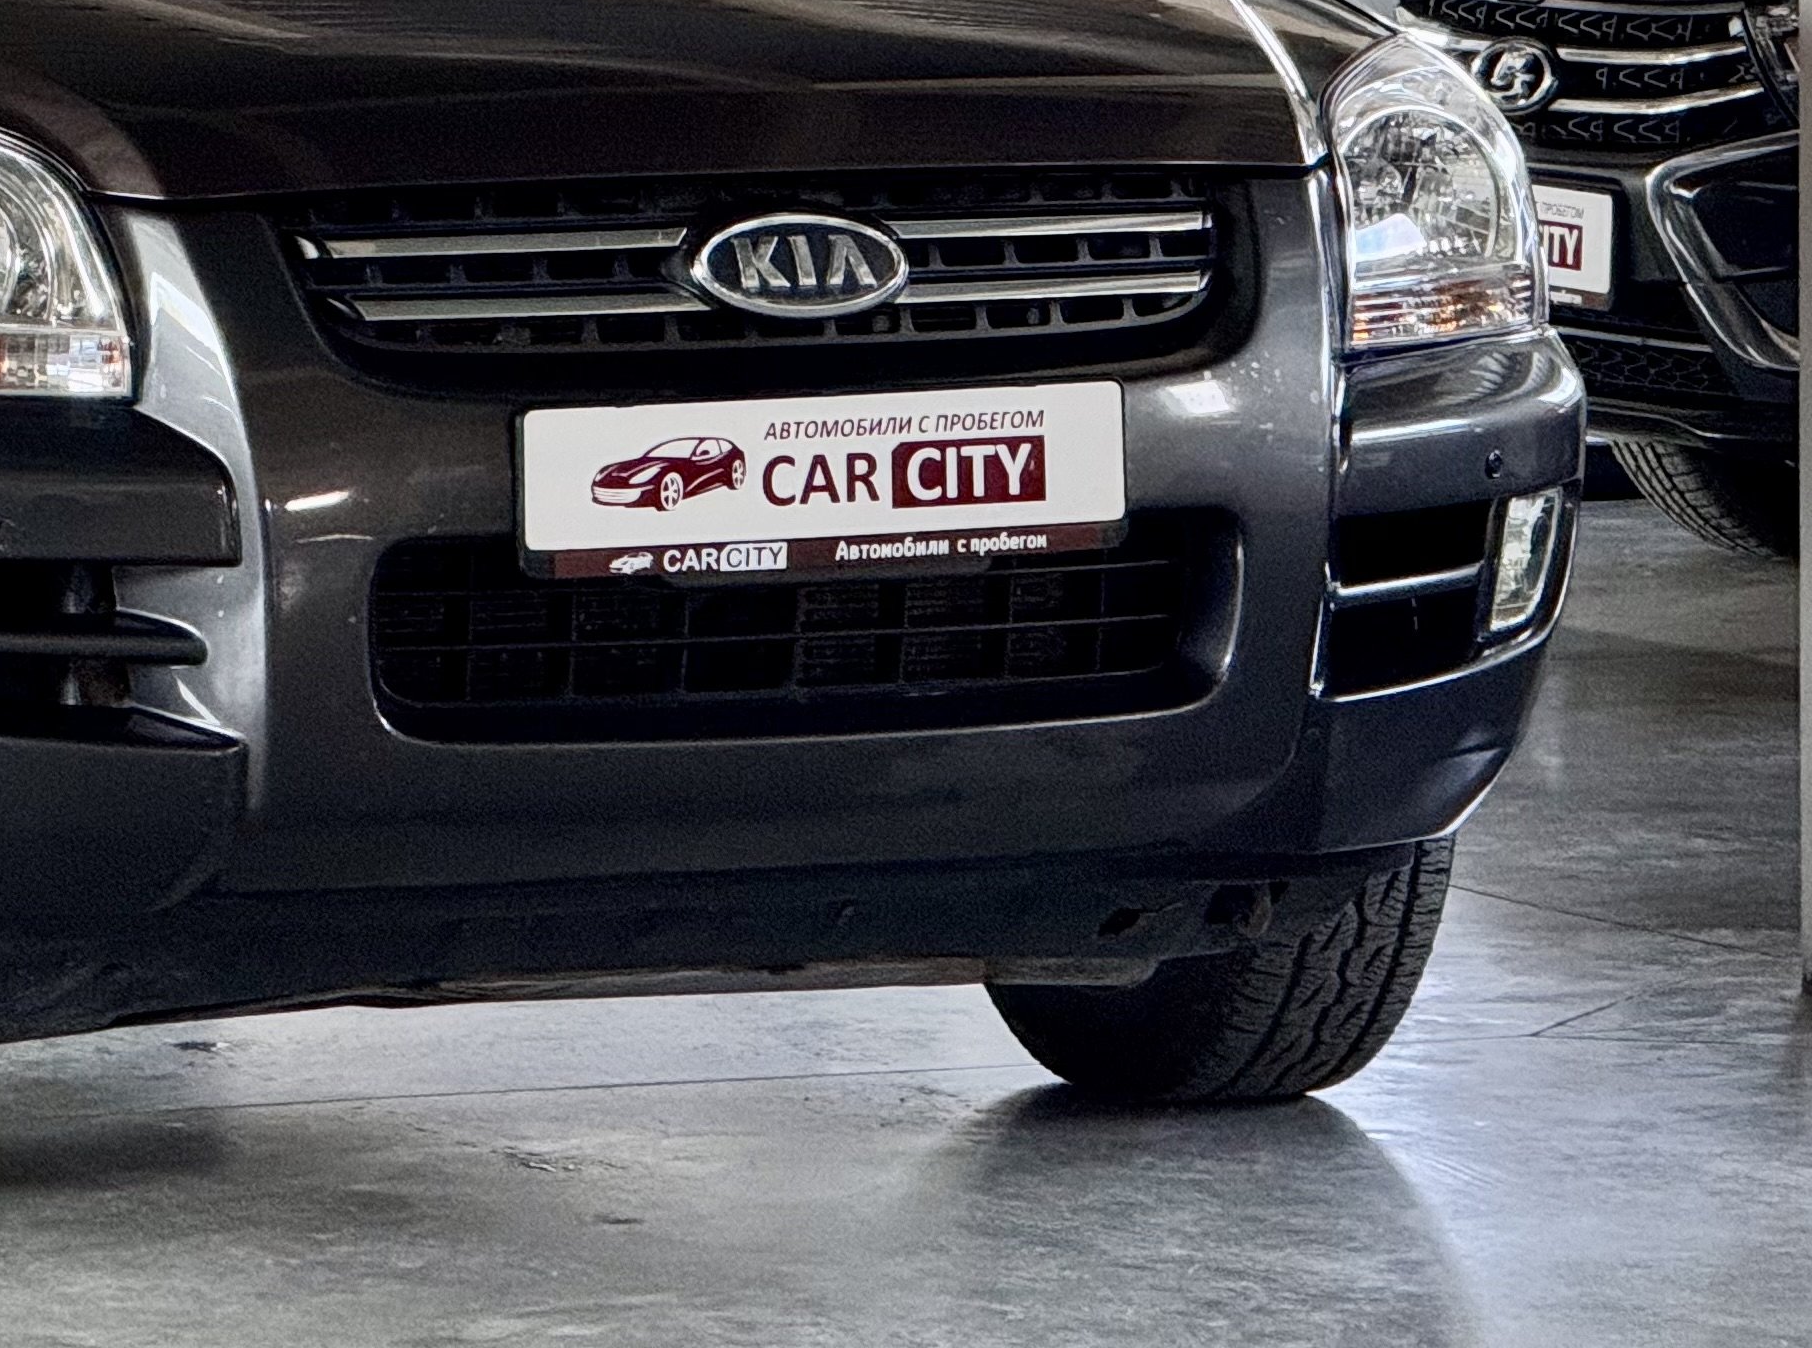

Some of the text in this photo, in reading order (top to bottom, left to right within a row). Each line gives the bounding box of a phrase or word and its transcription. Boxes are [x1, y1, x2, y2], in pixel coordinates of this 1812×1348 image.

[730, 235, 878, 289] KIA
[1539, 225, 1579, 266] ITY
[764, 410, 1045, 441] АВТОМОБИЛИ С ПРОБЕГОМ
[762, 443, 1032, 507] CAR CITY
[663, 543, 783, 573] CAR CITY
[835, 537, 950, 561] Автомобили
[970, 532, 1047, 556] пробегом
